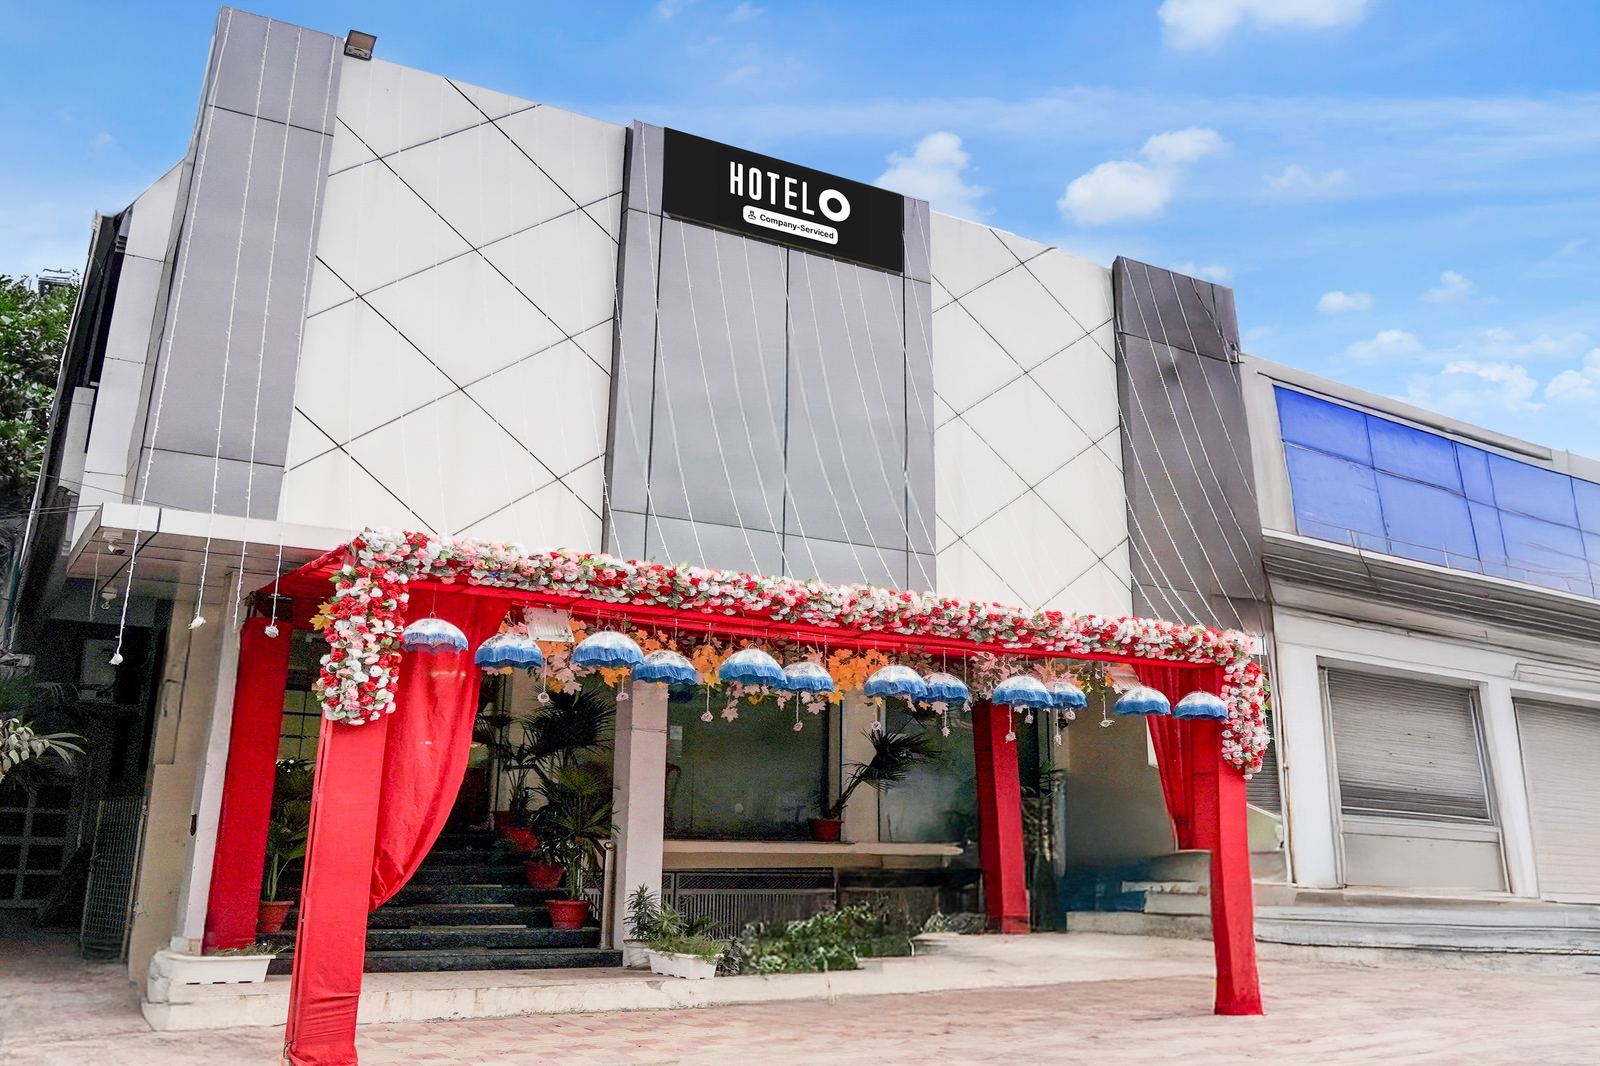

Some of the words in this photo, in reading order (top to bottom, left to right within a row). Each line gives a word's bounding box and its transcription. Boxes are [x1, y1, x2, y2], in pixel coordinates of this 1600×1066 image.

[729, 161, 814, 216] HOTEL
[818, 189, 851, 223] O
[760, 214, 834, 240] Company-Serviced
